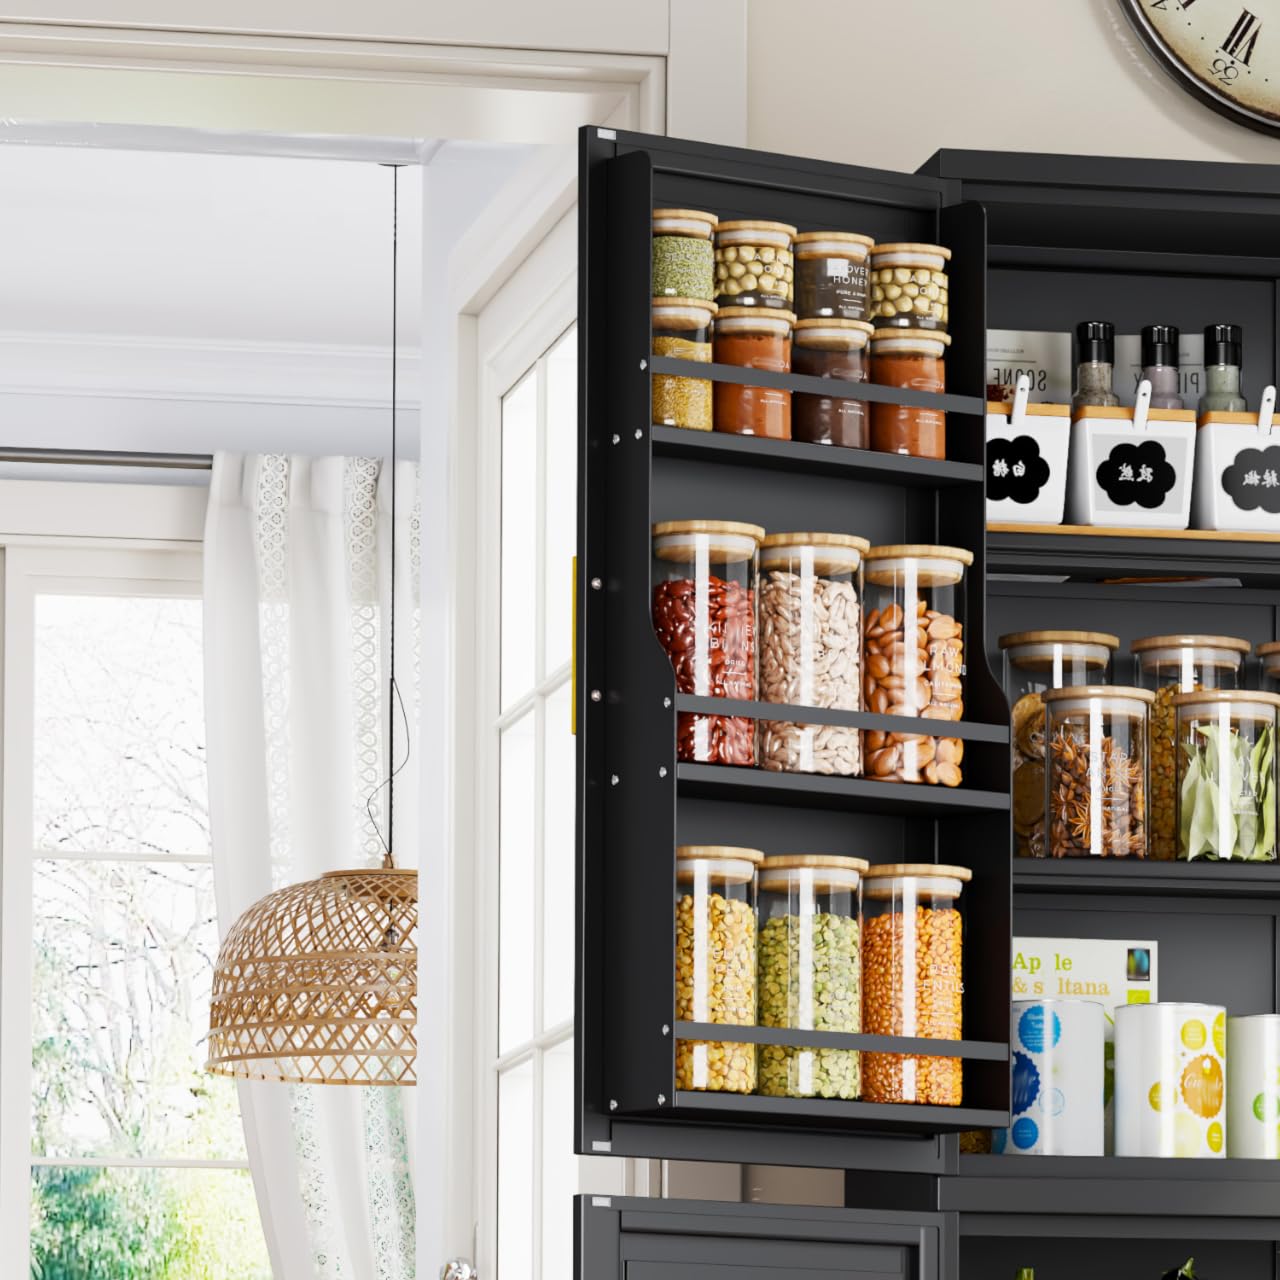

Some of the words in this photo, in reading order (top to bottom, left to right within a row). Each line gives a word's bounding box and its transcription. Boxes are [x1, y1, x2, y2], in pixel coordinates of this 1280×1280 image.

[1012, 952, 1041, 974] Ap
[1054, 953, 1072, 970] le
[1057, 977, 1110, 995] ltana
